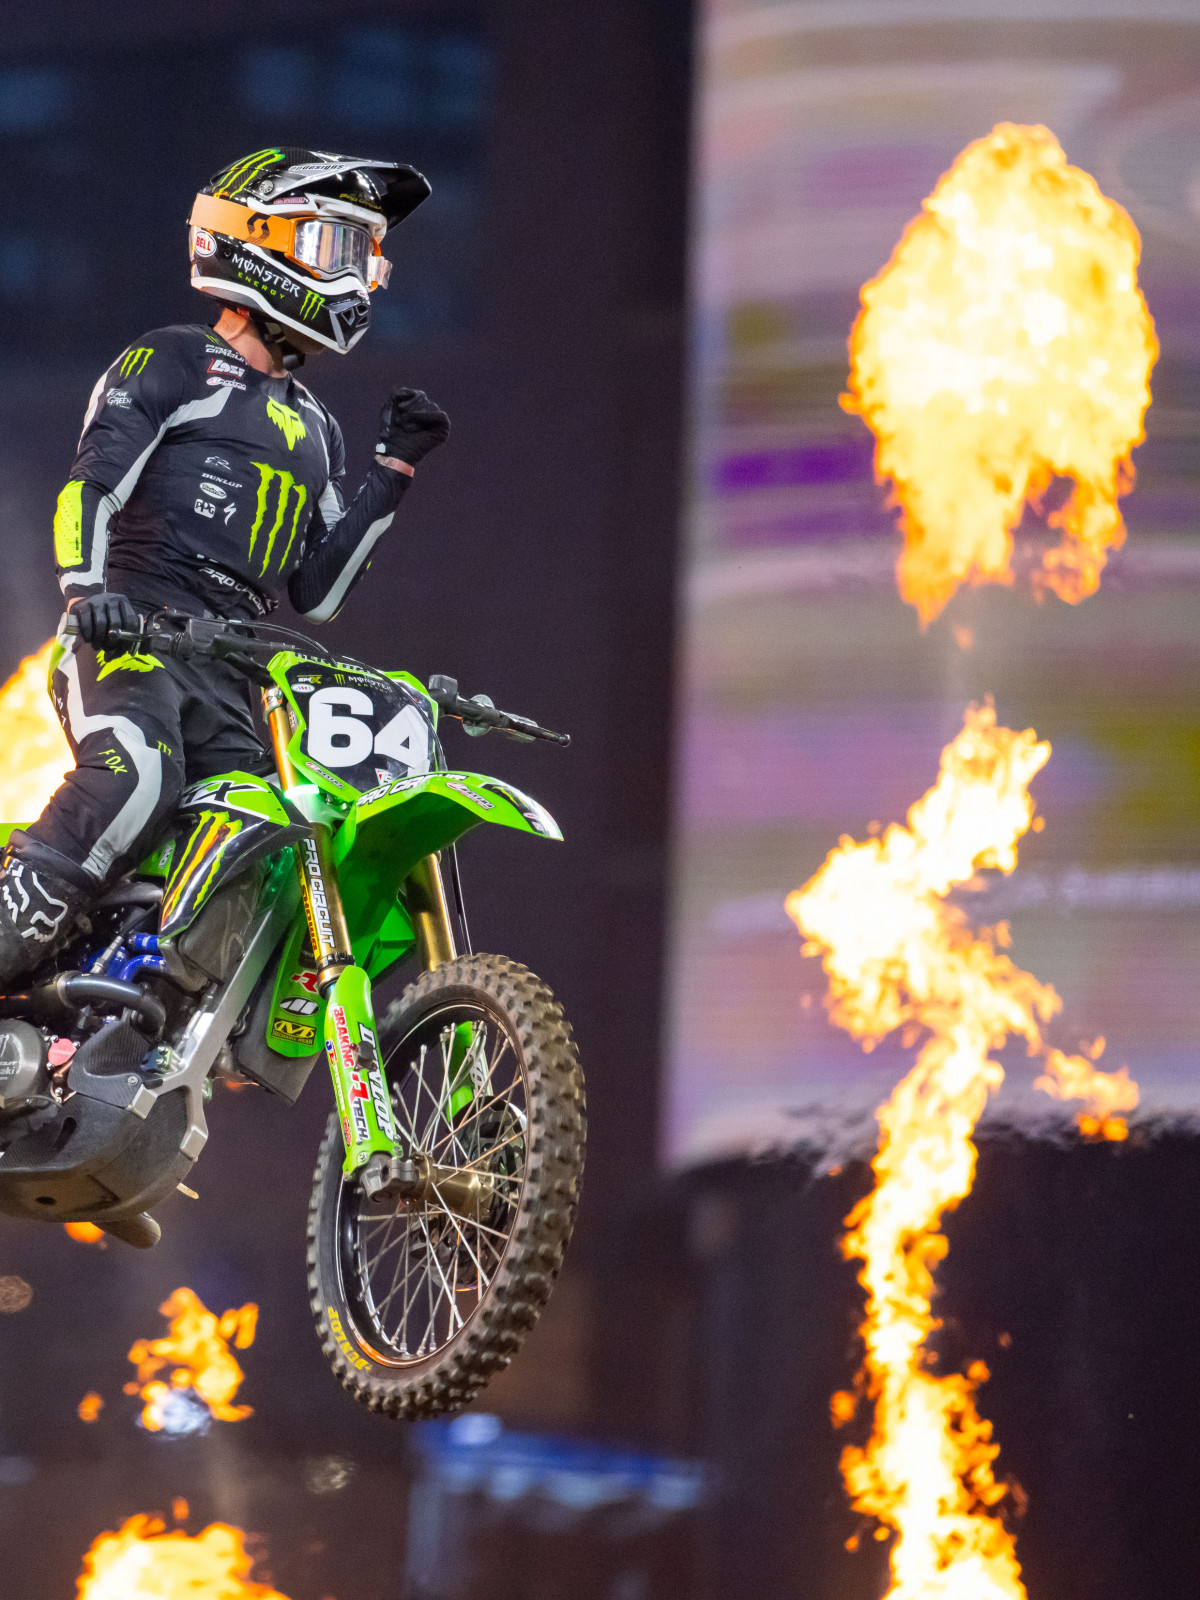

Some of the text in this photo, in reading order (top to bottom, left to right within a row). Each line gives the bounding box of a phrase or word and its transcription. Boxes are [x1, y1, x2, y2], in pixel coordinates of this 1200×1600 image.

[196, 238, 211, 251] BELL
[232, 254, 301, 298] MONSTER
[238, 272, 285, 299] ENERGY
[107, 396, 132, 405] GREEN
[201, 472, 243, 488] DUNLOP
[196, 501, 215, 515] PPG
[199, 567, 235, 587] PRO
[348, 675, 393, 693] MONSTER
[307, 687, 430, 775] 64
[98, 748, 128, 776] FOX
[302, 838, 335, 948] PRO CIRCUIT
[301, 884, 318, 951] SHOWA
[333, 1007, 355, 1068] BRAKING
[326, 1305, 373, 1372] DUNLOP
